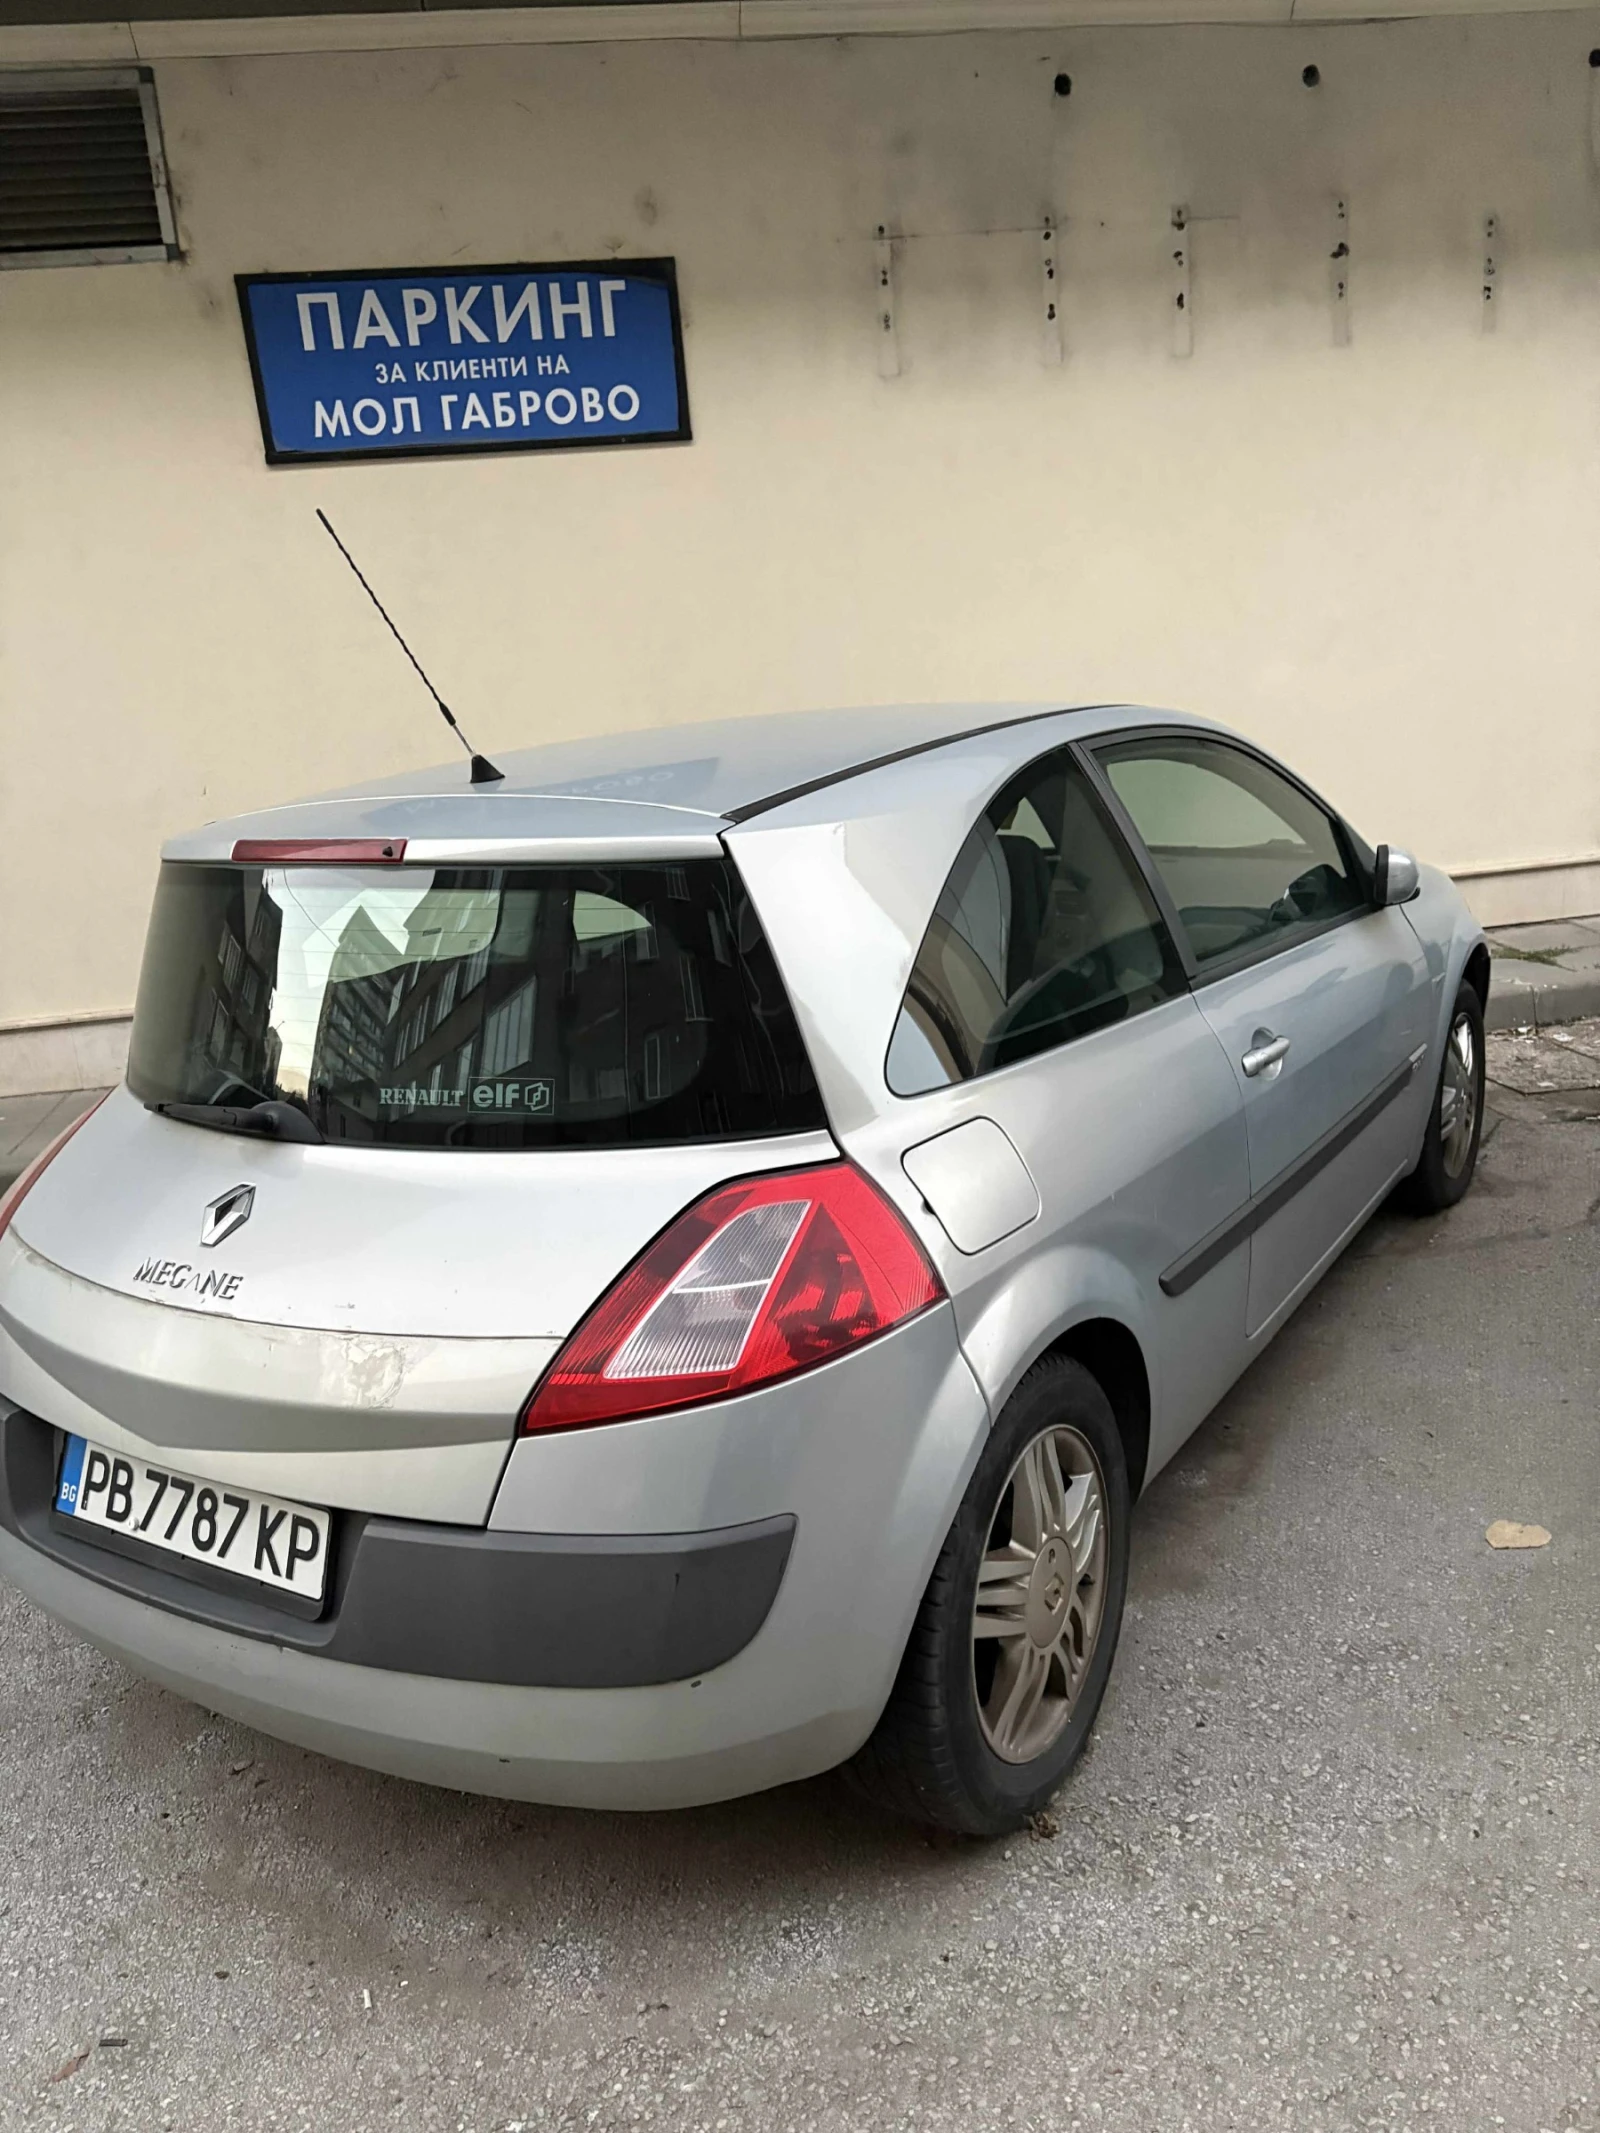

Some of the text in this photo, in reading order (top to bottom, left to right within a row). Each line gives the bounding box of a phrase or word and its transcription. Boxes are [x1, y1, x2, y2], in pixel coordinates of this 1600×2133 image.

[296, 279, 626, 351] ПАРКИНГ
[375, 354, 571, 384] ЗА КЛИЕНТИ НА
[314, 384, 641, 438] МОЛ ГАБРОВО
[379, 1083, 520, 1108] RENAULT elf
[133, 1257, 244, 1300] MEGANE
[60, 1481, 77, 1503] BG
[139, 1468, 250, 1558] 7787
[254, 1503, 320, 1581] KP
